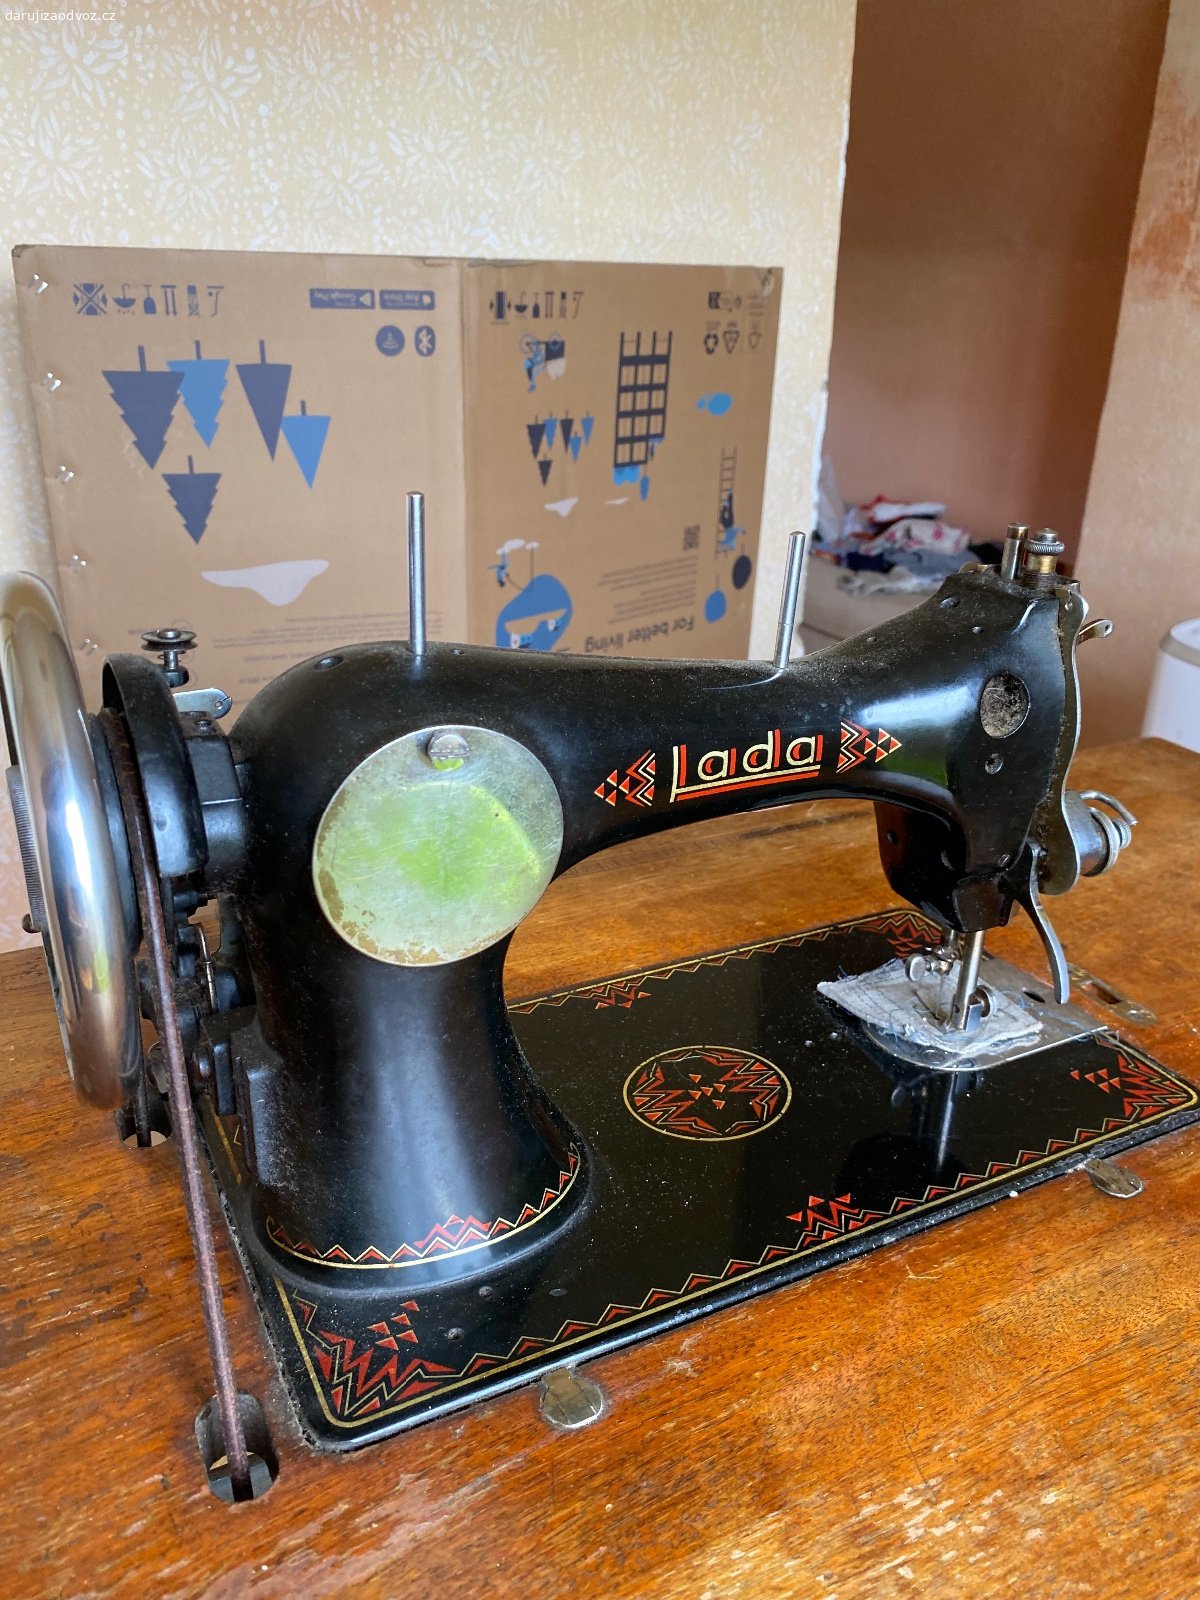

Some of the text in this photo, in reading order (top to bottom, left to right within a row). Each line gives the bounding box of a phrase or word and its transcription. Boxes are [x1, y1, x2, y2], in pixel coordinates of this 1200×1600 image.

[584, 616, 694, 653] For better living
[669, 728, 824, 803] Lada
